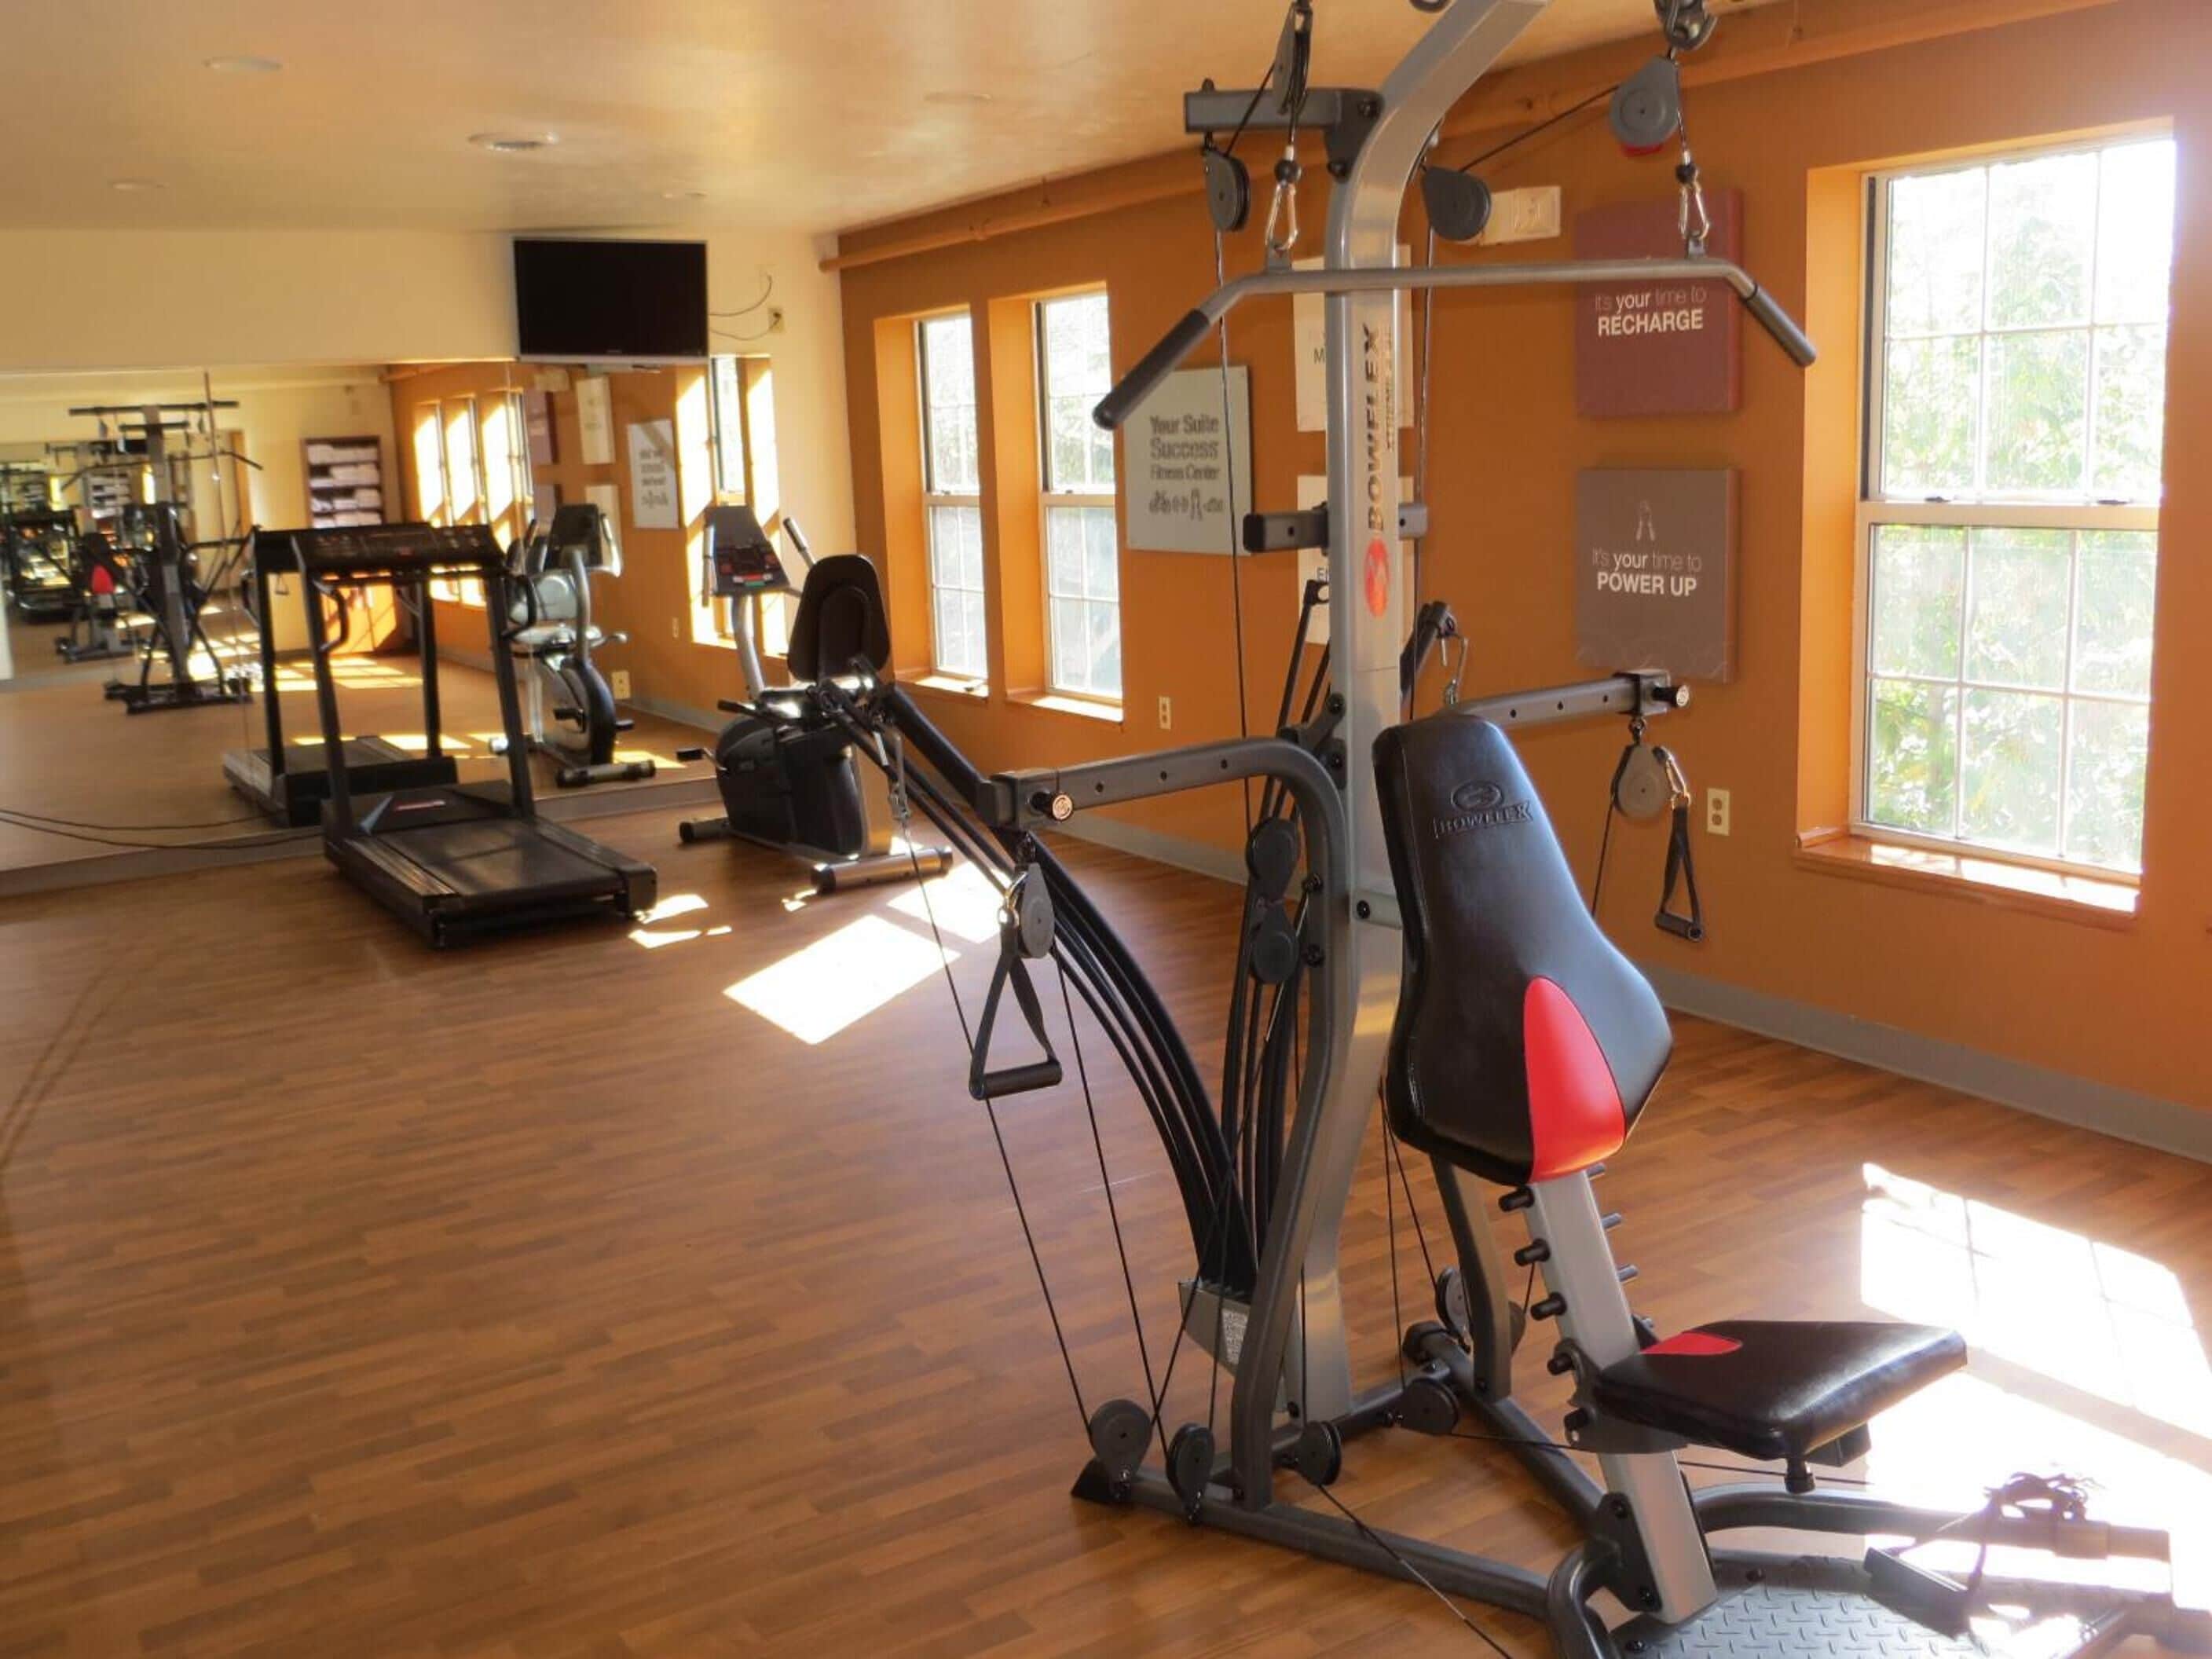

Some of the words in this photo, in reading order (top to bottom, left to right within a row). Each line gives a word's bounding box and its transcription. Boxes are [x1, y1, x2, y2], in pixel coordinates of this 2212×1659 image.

[1616, 292, 1650, 314] your
[1655, 287, 1686, 306] time
[1691, 285, 1707, 303] to
[1598, 309, 1704, 338] RECHARGE
[1149, 415, 1179, 434] Your
[1183, 413, 1219, 434] Suite
[1363, 322, 1384, 531] BOWFLEX
[1149, 437, 1219, 460] Success
[1613, 553, 1648, 572] your
[1652, 550, 1683, 571] time
[1688, 553, 1702, 573] to
[1597, 571, 1664, 595] POWER
[1670, 577, 1697, 596] UP
